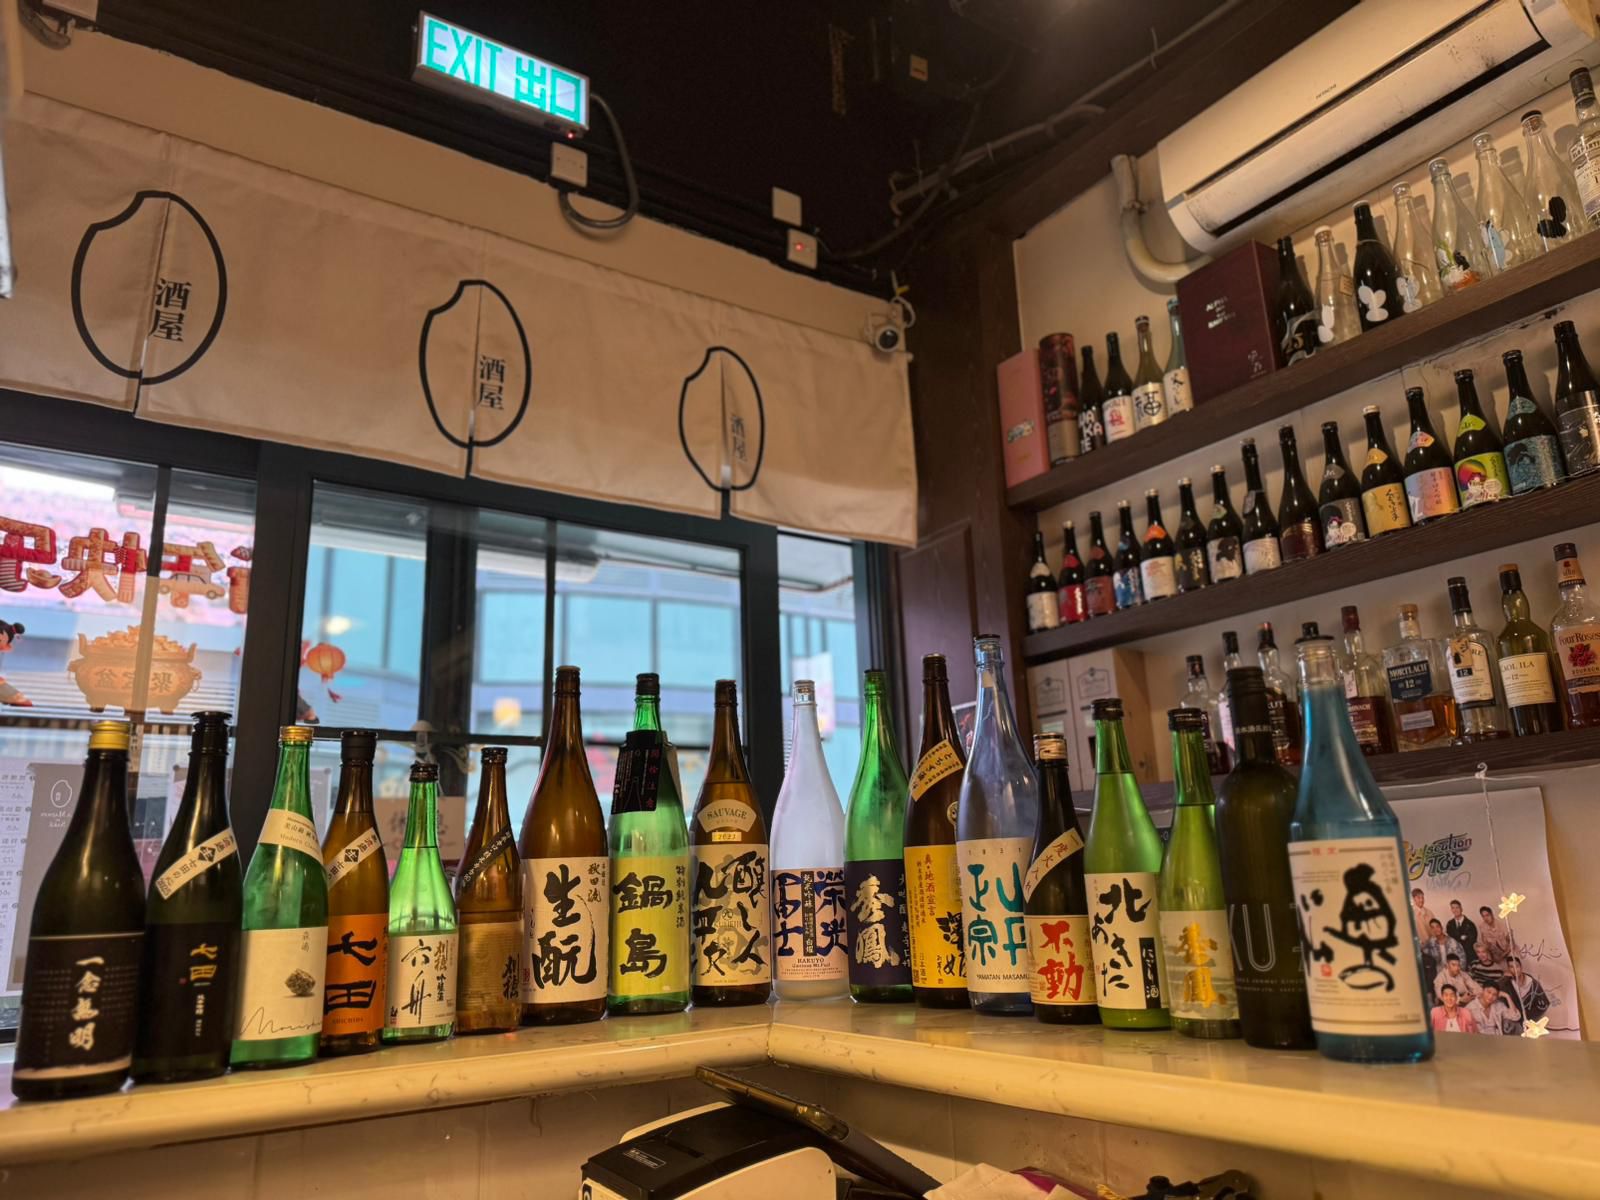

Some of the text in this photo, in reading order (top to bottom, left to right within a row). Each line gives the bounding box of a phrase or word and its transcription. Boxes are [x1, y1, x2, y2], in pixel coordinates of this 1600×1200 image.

[427, 20, 582, 123] EXIT 出口
[149, 277, 192, 343] 酒屋
[477, 355, 506, 411] 酒屋
[1389, 664, 1428, 678] MORTLACH
[1405, 679, 1415, 688] 12
[706, 807, 748, 821] SAUVAGE
[612, 872, 673, 978] 鍋島
[190, 943, 218, 981] 七田
[324, 931, 378, 1016] 七田
[1037, 920, 1085, 1001] 不動
